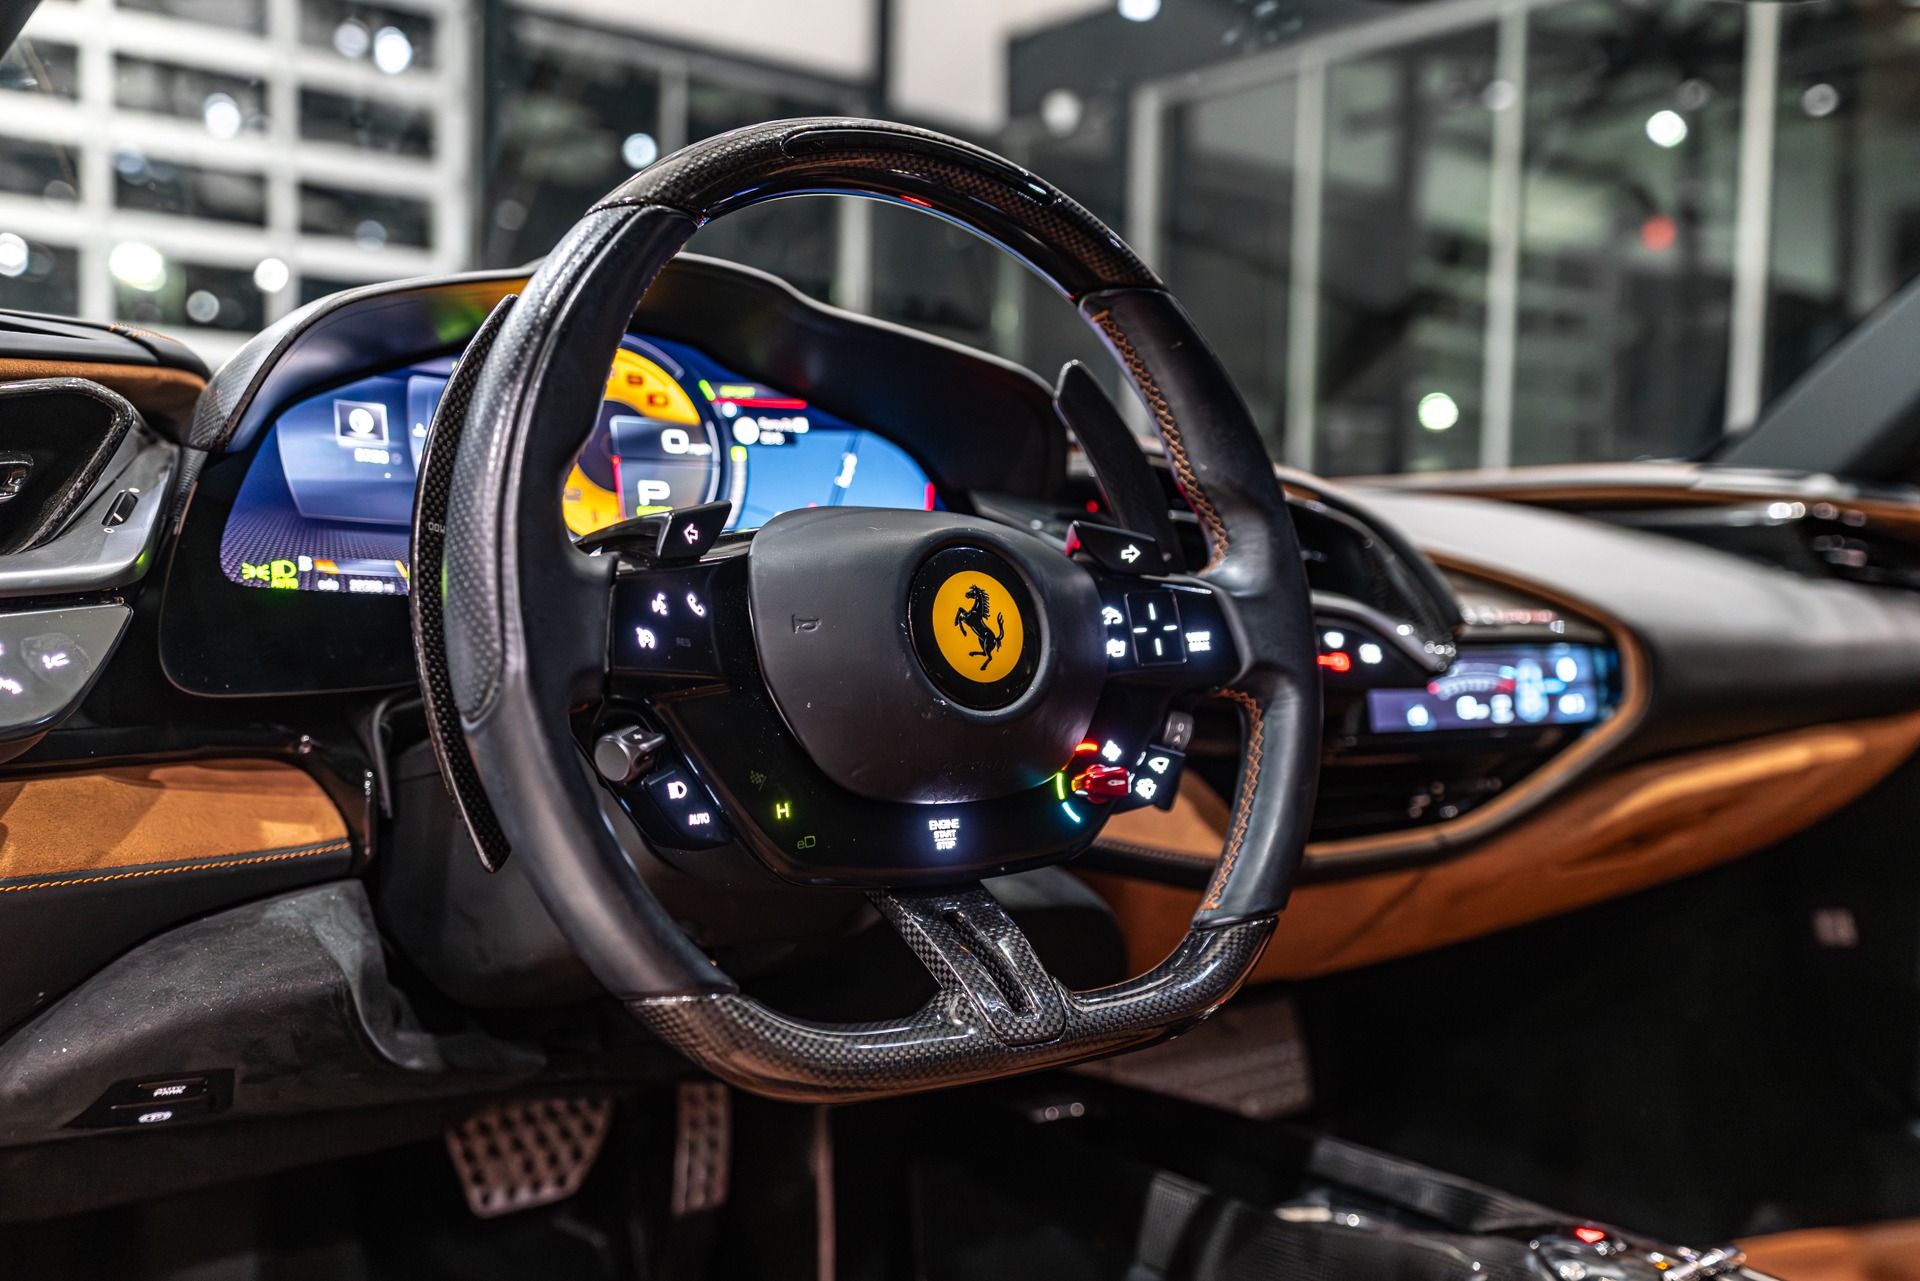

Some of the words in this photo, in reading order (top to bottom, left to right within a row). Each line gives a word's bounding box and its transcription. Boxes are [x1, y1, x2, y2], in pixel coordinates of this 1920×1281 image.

[637, 479, 671, 506] P
[428, 521, 446, 535] DOW
[775, 802, 791, 821] H
[688, 811, 711, 827] AUTO
[928, 818, 960, 831] ENGINE
[933, 829, 957, 840] START
[797, 835, 816, 850] eD
[936, 840, 956, 851] STOP
